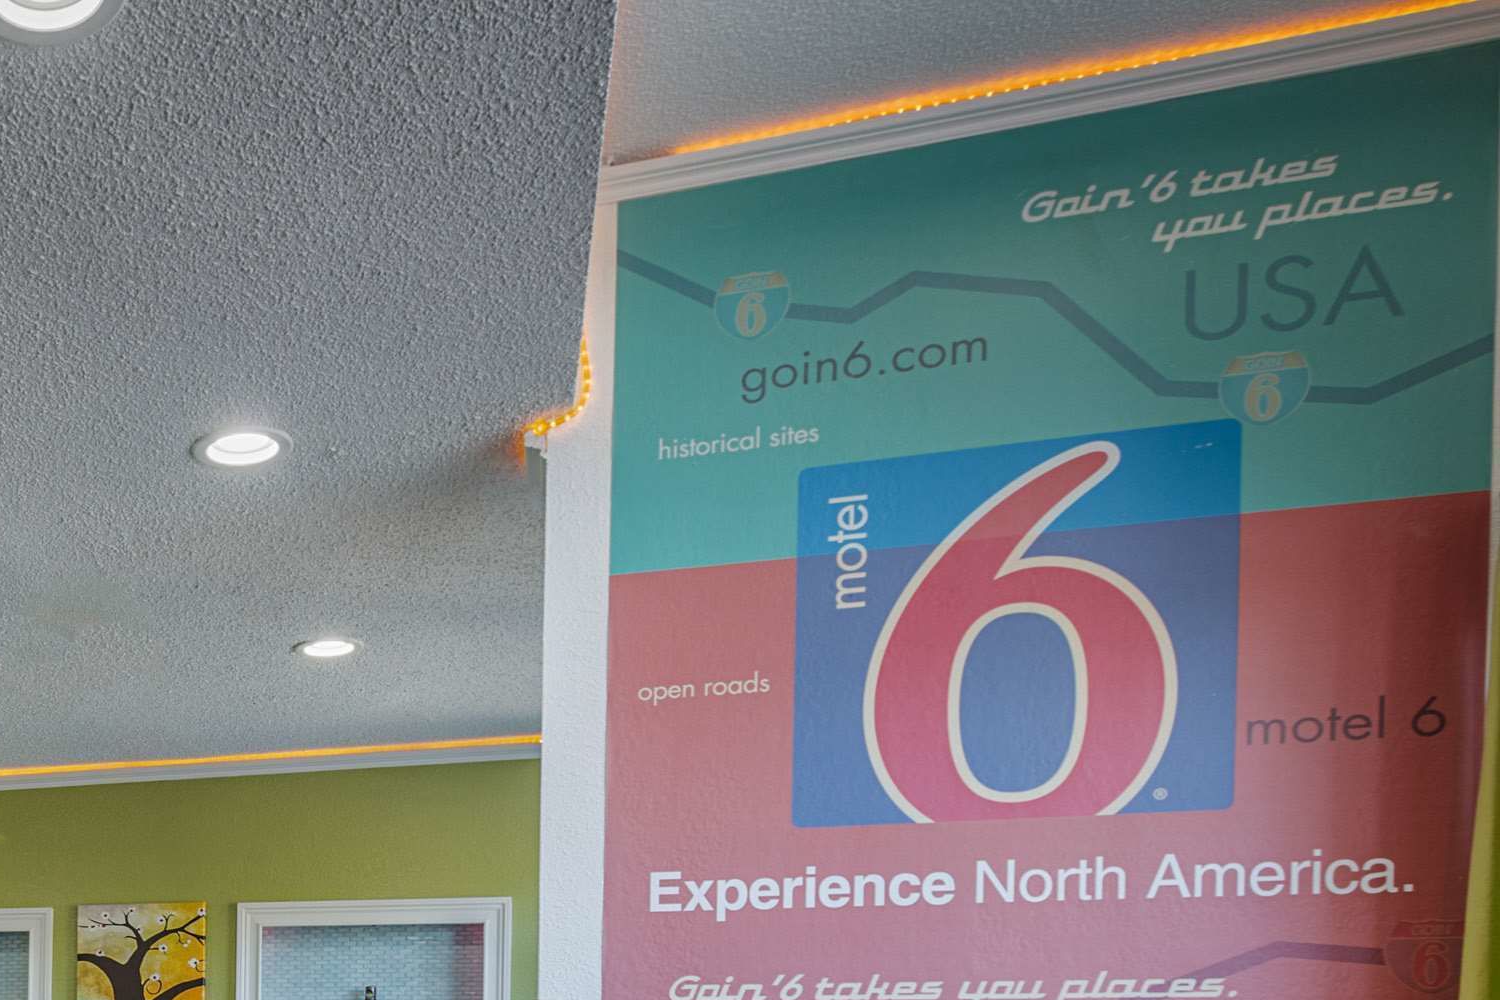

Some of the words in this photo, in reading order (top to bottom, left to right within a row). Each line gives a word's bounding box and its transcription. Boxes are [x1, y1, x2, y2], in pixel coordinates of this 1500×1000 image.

[1189, 154, 1340, 199] takes
[1151, 209, 1248, 253] you
[1253, 181, 1454, 240] places.
[735, 291, 767, 337] 6
[1184, 244, 1405, 341] USA
[741, 336, 988, 404] goin6.com
[1244, 373, 1283, 421] 6
[658, 426, 760, 460] historical
[769, 425, 820, 448] sites
[828, 494, 869, 610] motel
[863, 440, 1178, 824] 6
[638, 683, 695, 706] open
[704, 670, 771, 696] roads
[1247, 695, 1386, 745] motel
[1411, 696, 1446, 737] 6
[648, 865, 956, 922] Experience
[975, 855, 1126, 904] North
[1146, 849, 1415, 900] America.
[814, 974, 945, 1000] takes
[1412, 941, 1451, 988] 6
